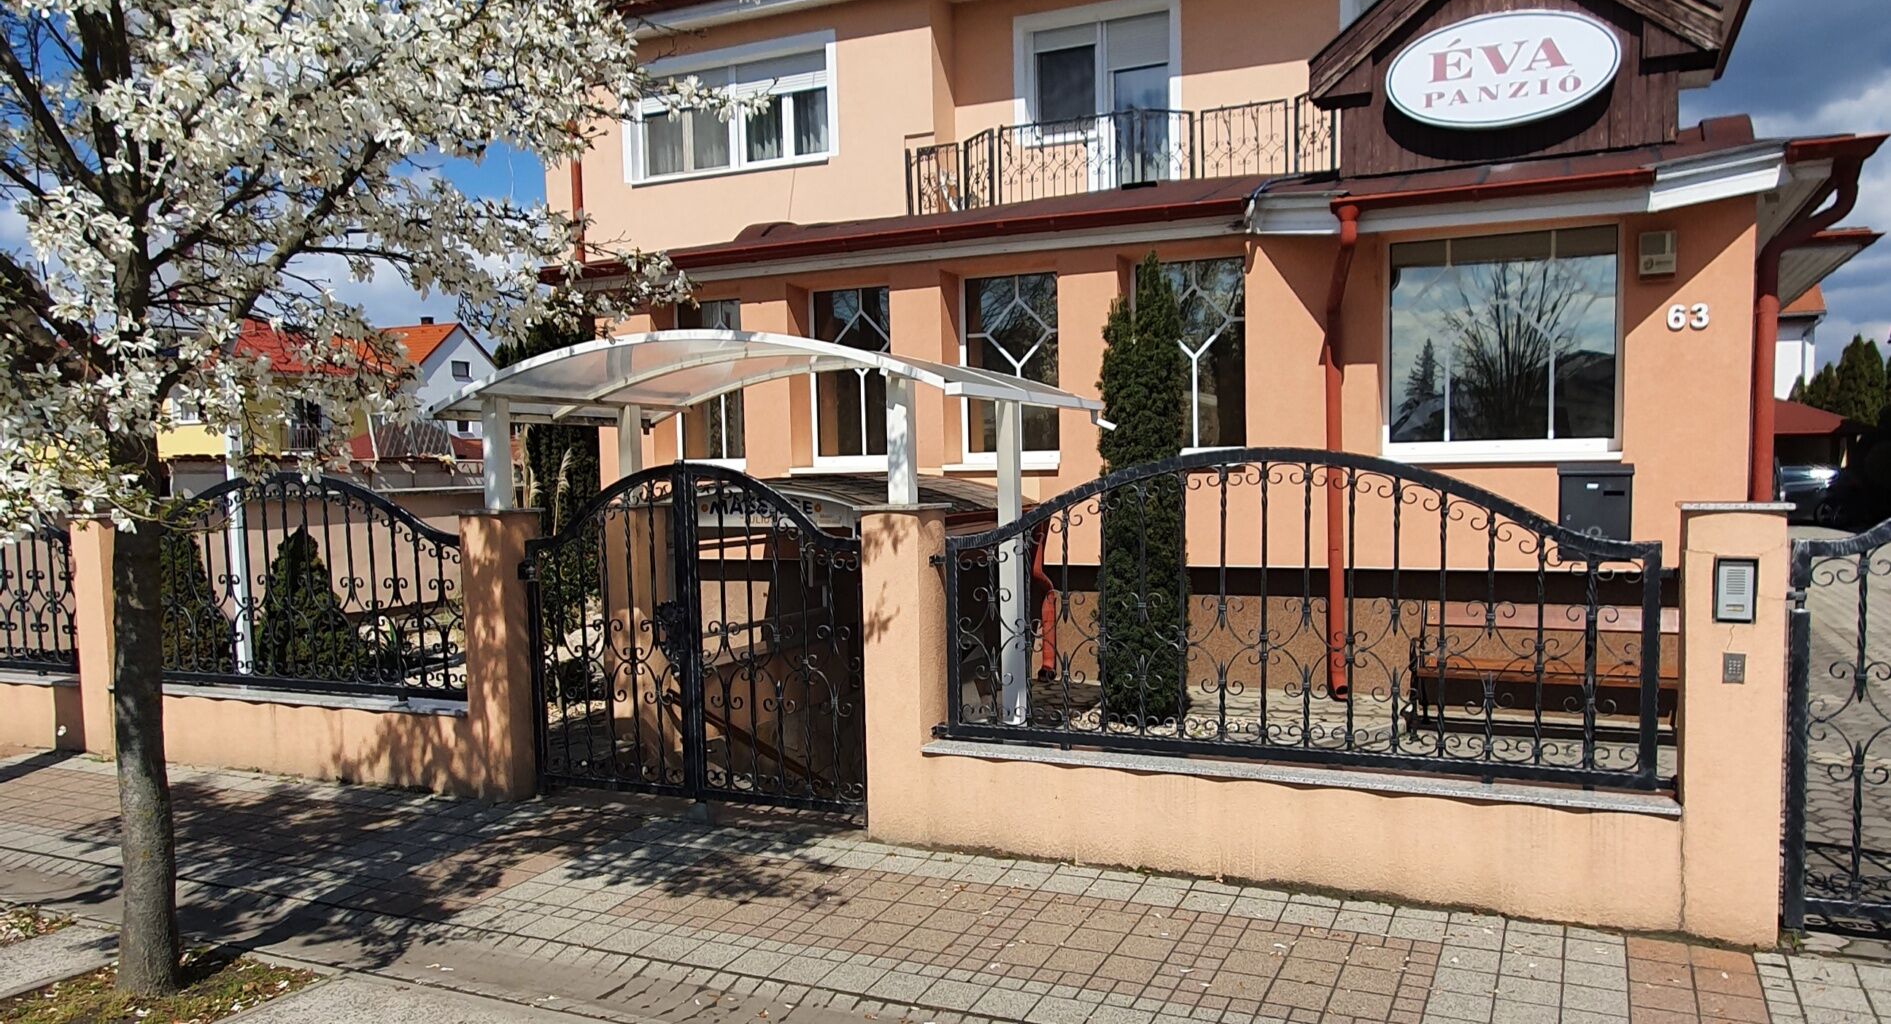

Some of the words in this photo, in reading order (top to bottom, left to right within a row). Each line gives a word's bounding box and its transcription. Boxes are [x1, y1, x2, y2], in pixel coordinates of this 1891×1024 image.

[1427, 37, 1573, 84] ÉVA
[1423, 69, 1582, 109] PANZIÓ
[1666, 302, 1710, 331] 63
